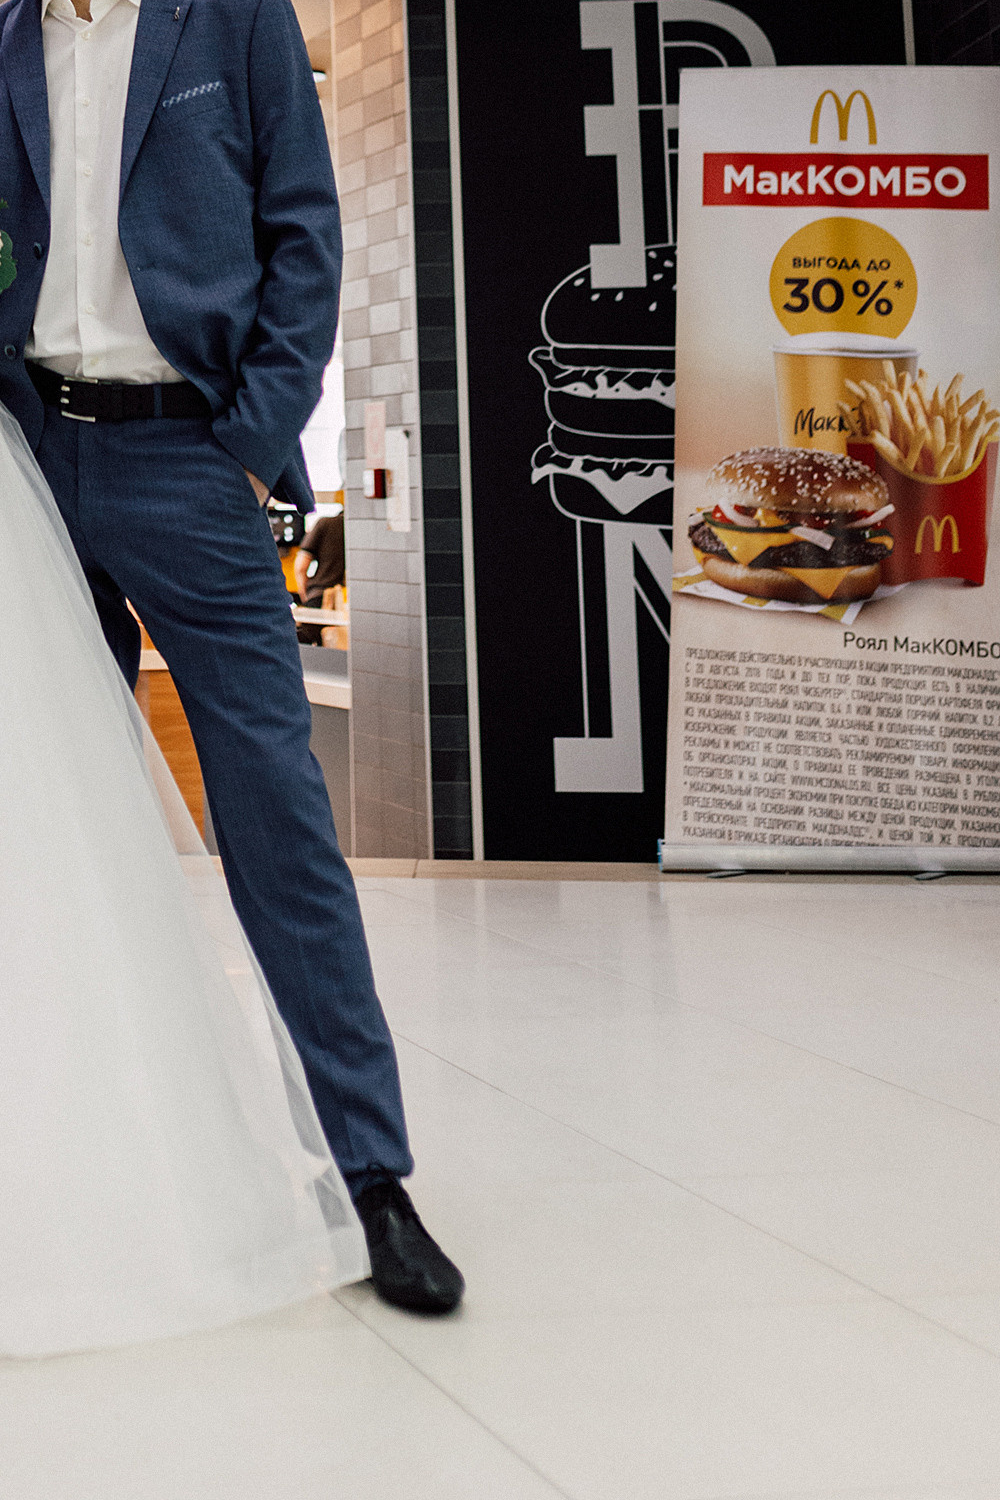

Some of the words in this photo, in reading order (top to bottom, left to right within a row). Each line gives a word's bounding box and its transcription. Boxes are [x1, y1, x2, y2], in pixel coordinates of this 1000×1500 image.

[722, 164, 968, 198] МакКОМБО
[791, 256, 861, 271] ВЫГОДА
[866, 258, 891, 272] ДО
[843, 631, 889, 651] Роял
[893, 635, 1000, 659] МакКОМБО
